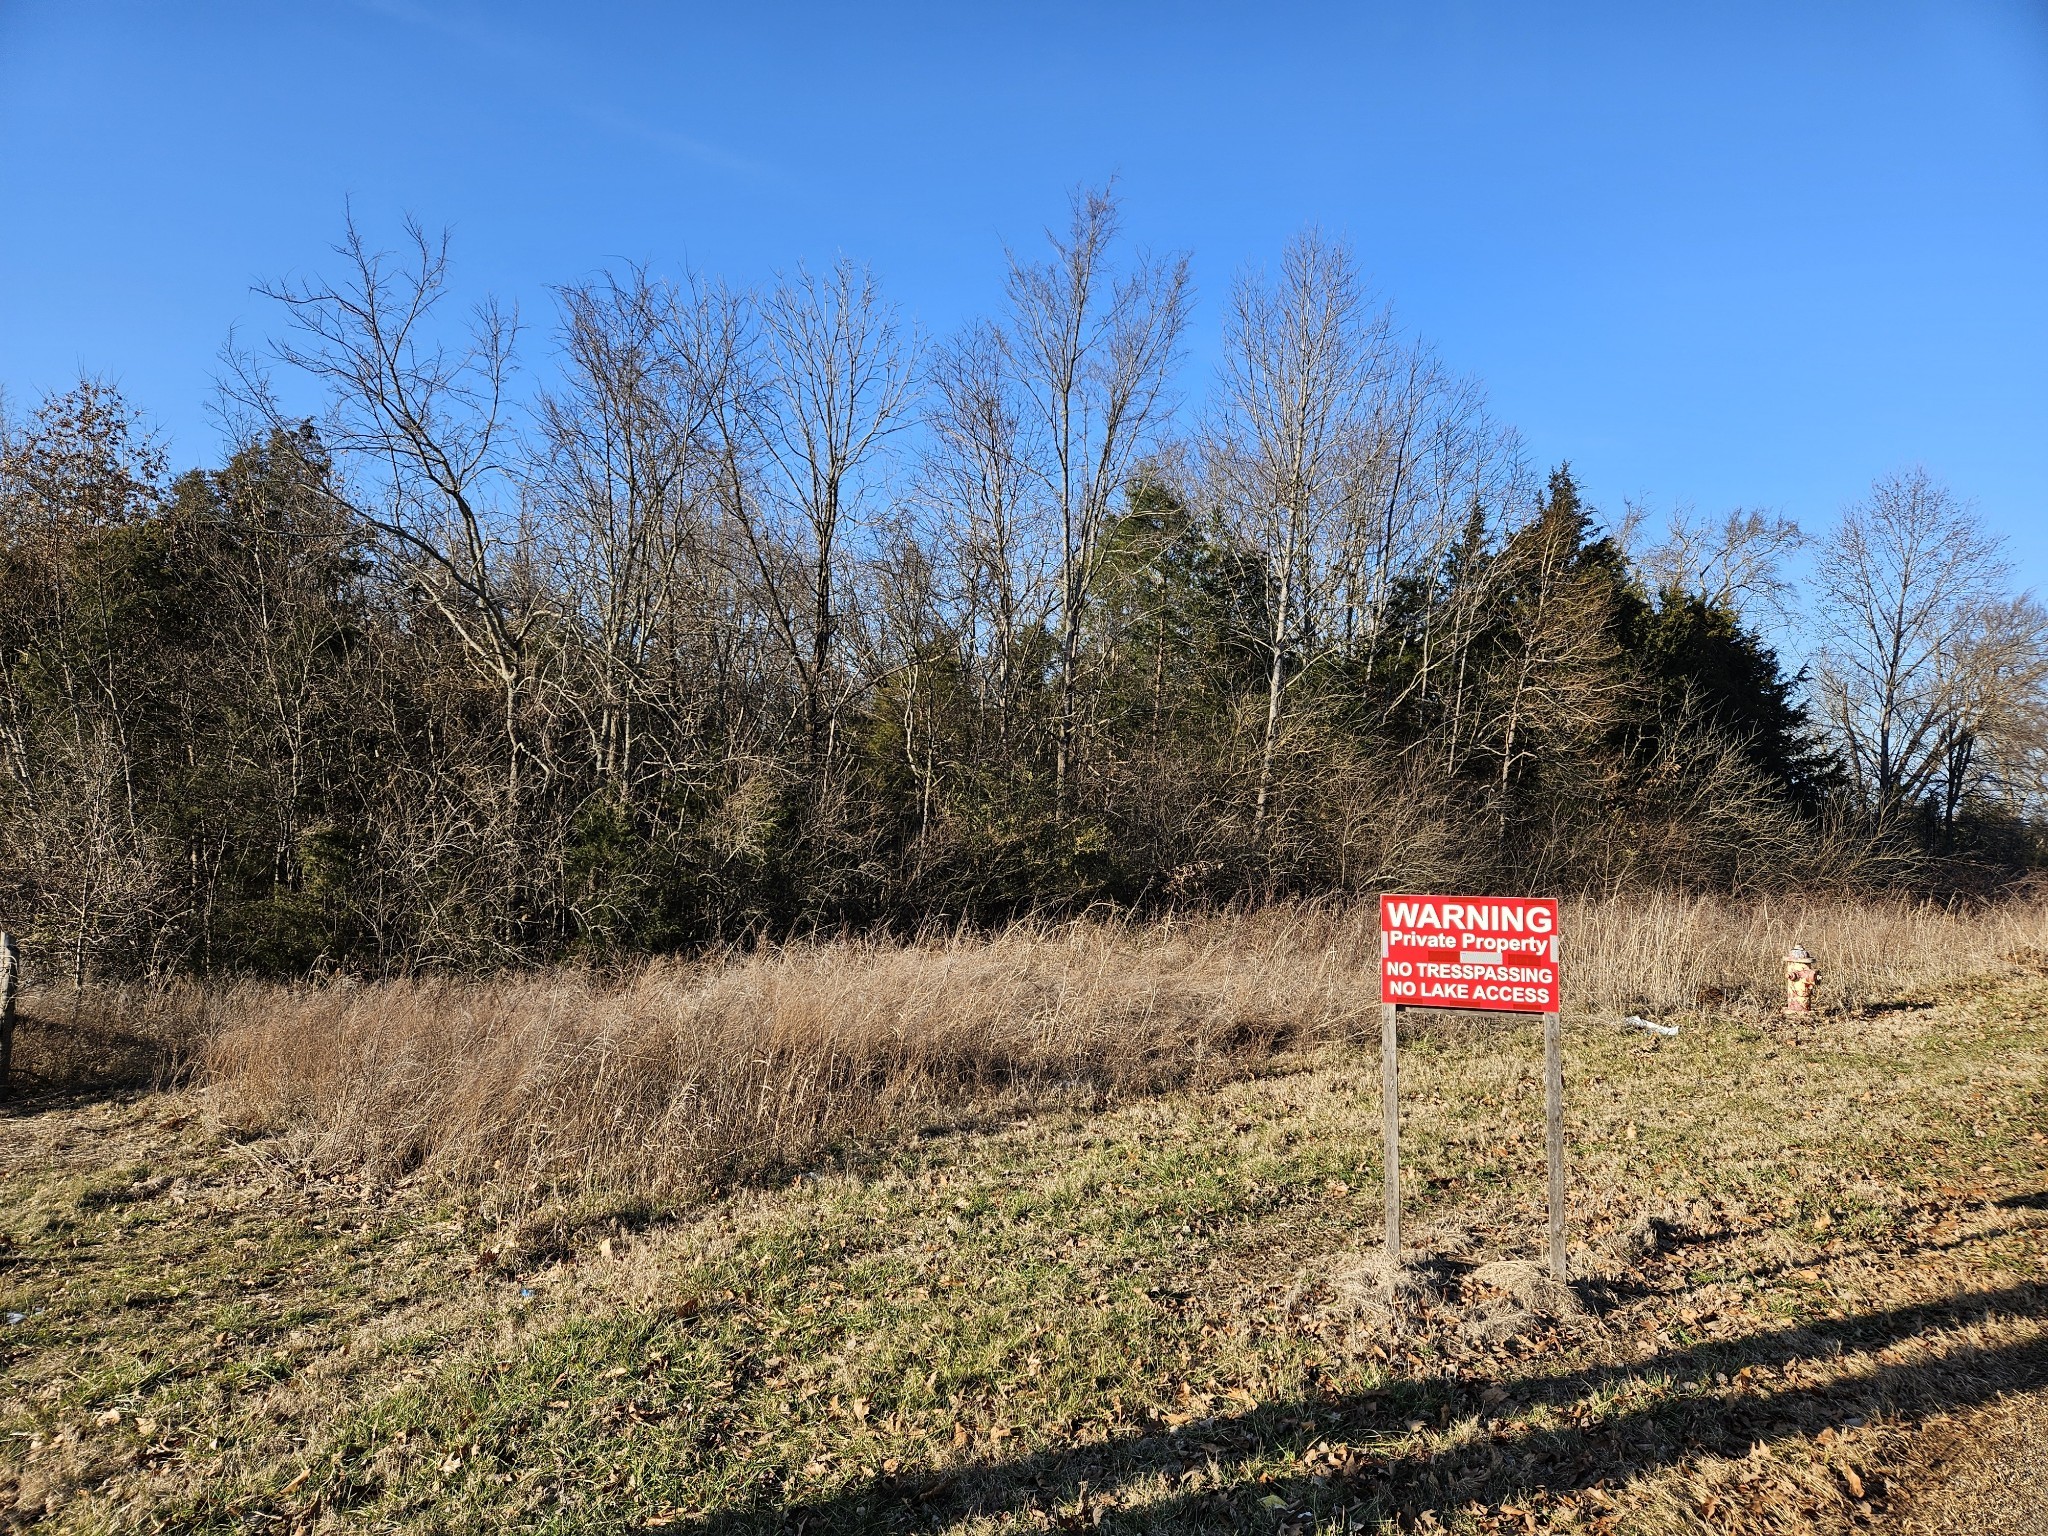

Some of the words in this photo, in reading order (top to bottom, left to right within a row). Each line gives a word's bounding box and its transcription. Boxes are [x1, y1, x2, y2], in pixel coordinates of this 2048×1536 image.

[1387, 902, 1552, 933] WARNING
[1390, 930, 1457, 948] Private
[1462, 932, 1548, 955] Property
[1387, 961, 1413, 977] NO
[1416, 962, 1553, 984] TRESSPASSING
[1390, 981, 1416, 996] NO
[1421, 982, 1469, 999] LAKE
[1472, 985, 1550, 1004] ACCESS
